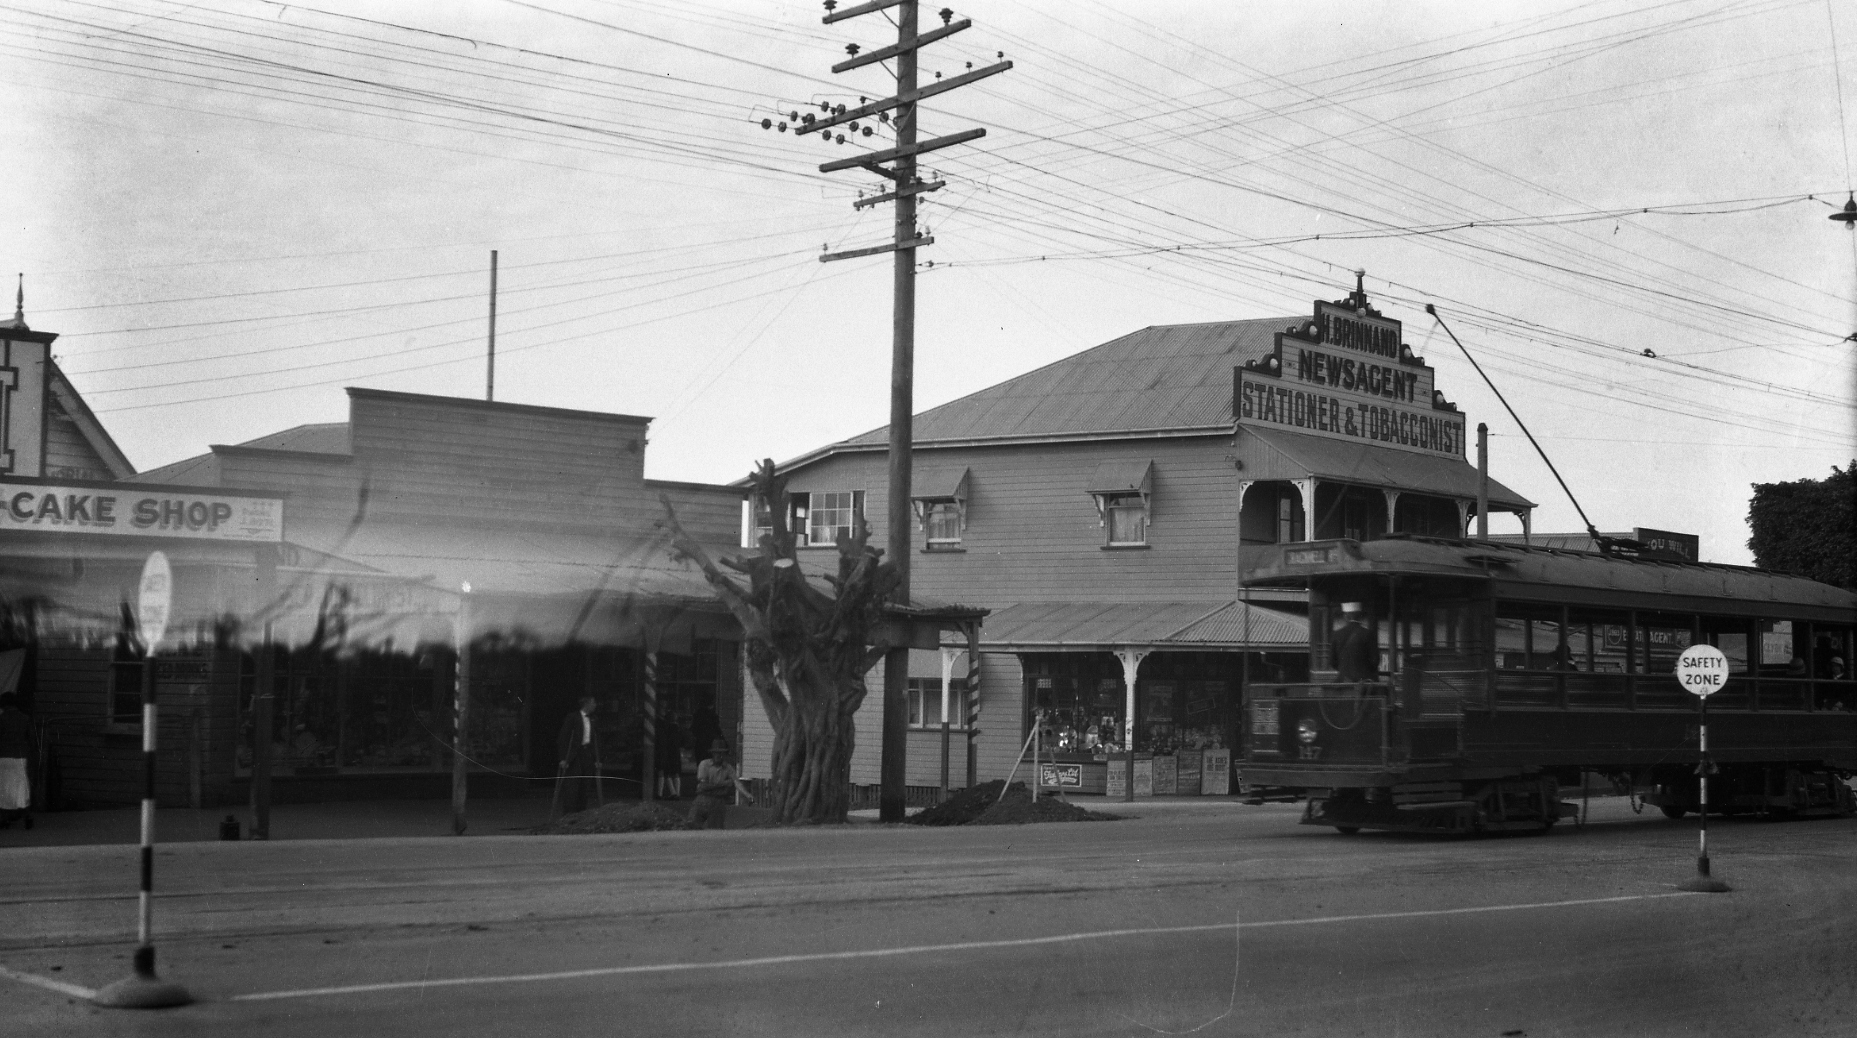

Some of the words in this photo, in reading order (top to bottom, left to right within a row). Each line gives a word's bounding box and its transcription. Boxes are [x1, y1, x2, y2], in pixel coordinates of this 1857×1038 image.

[1298, 349, 1417, 403] NEWSAGENT
[1242, 381, 1340, 434] STATIONER
[1344, 406, 1359, 437] &
[1358, 403, 1462, 455] TOBACCONIST
[9, 491, 117, 527] CAKE
[132, 498, 232, 531] SHOP
[1668, 540, 1691, 560] WILL
[1683, 657, 1722, 668] SAFETY
[1685, 674, 1720, 686] ZONE
